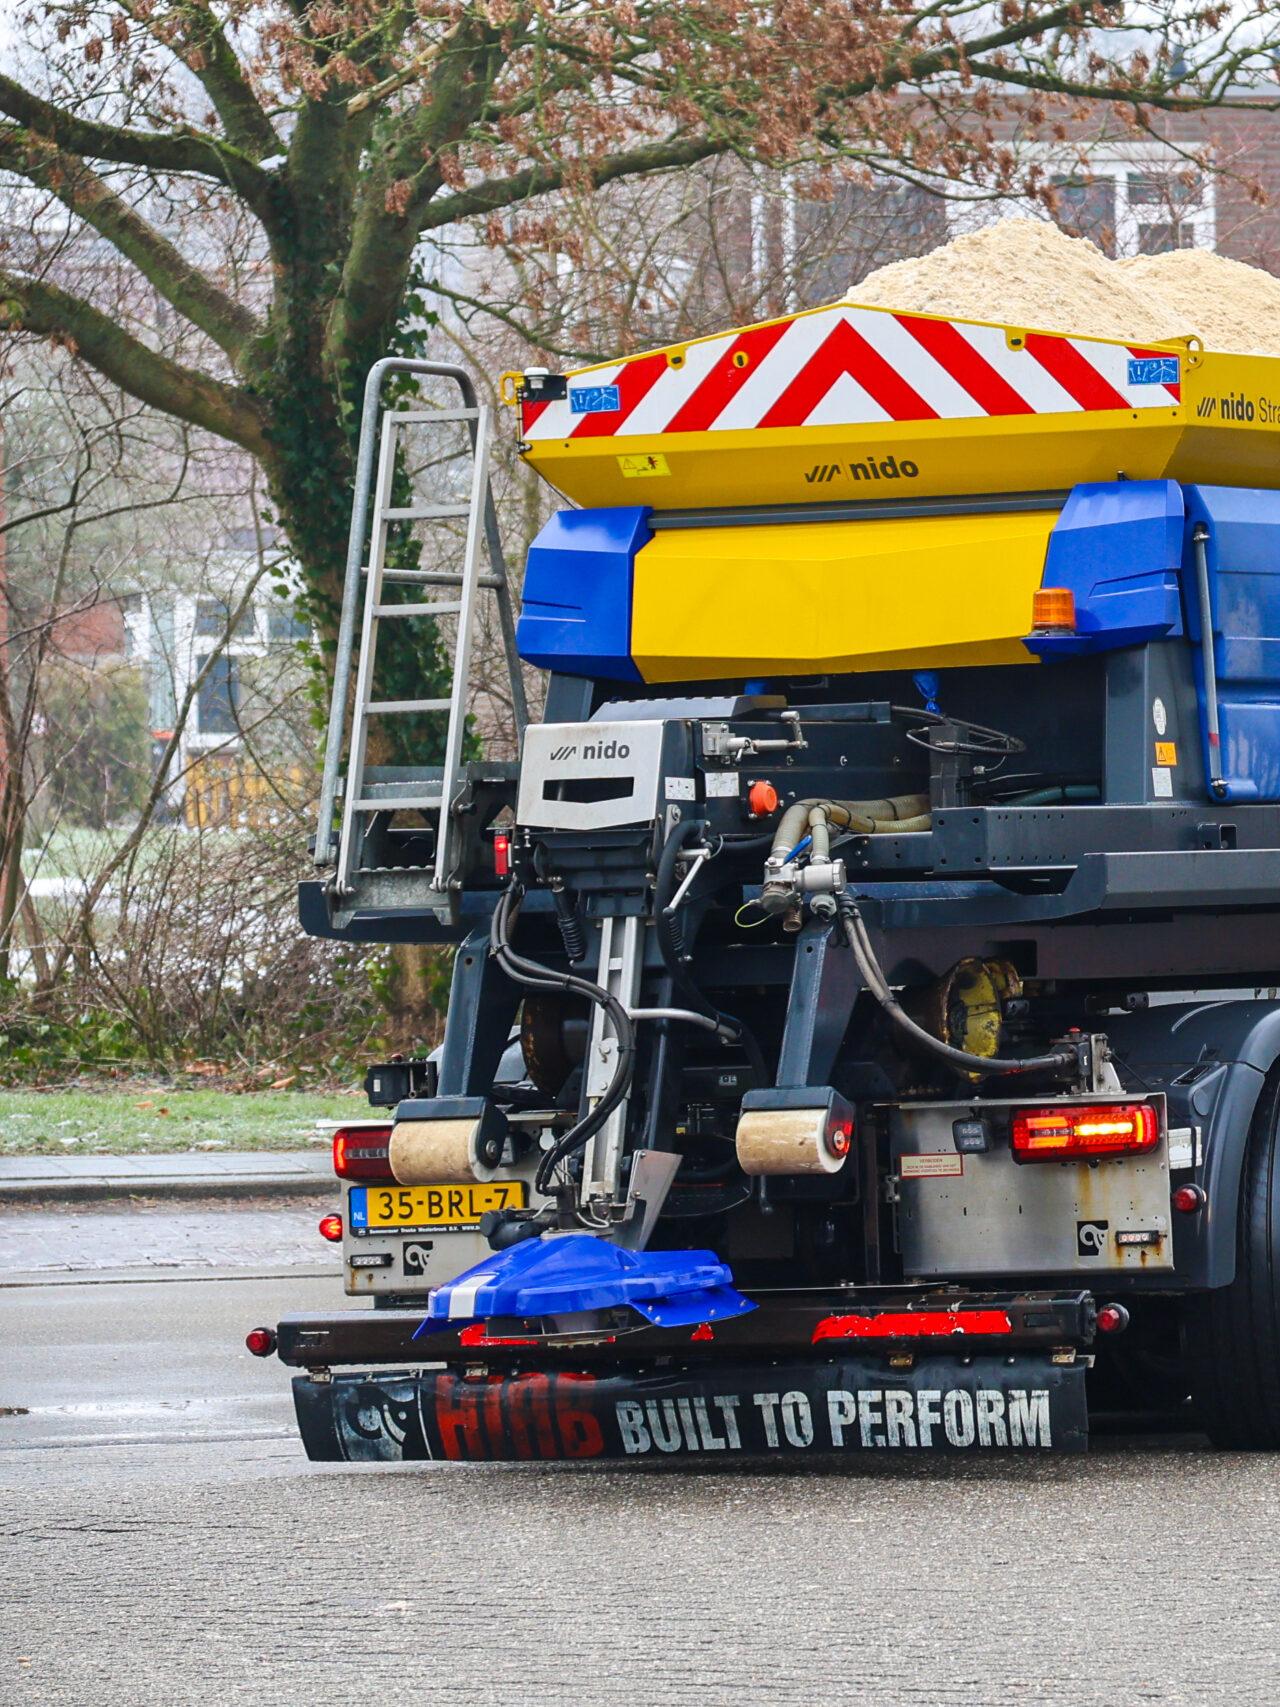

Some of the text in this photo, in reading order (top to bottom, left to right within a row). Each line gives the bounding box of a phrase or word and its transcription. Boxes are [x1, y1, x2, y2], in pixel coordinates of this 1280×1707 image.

[1220, 392, 1254, 421] nido
[849, 455, 919, 480] nido
[583, 740, 630, 759] nido
[353, 1211, 366, 1222] NL
[378, 1187, 509, 1220] 35-BRL-7
[435, 1372, 605, 1460] HIAB
[615, 1389, 1052, 1455] BUILT TO PERFORM
